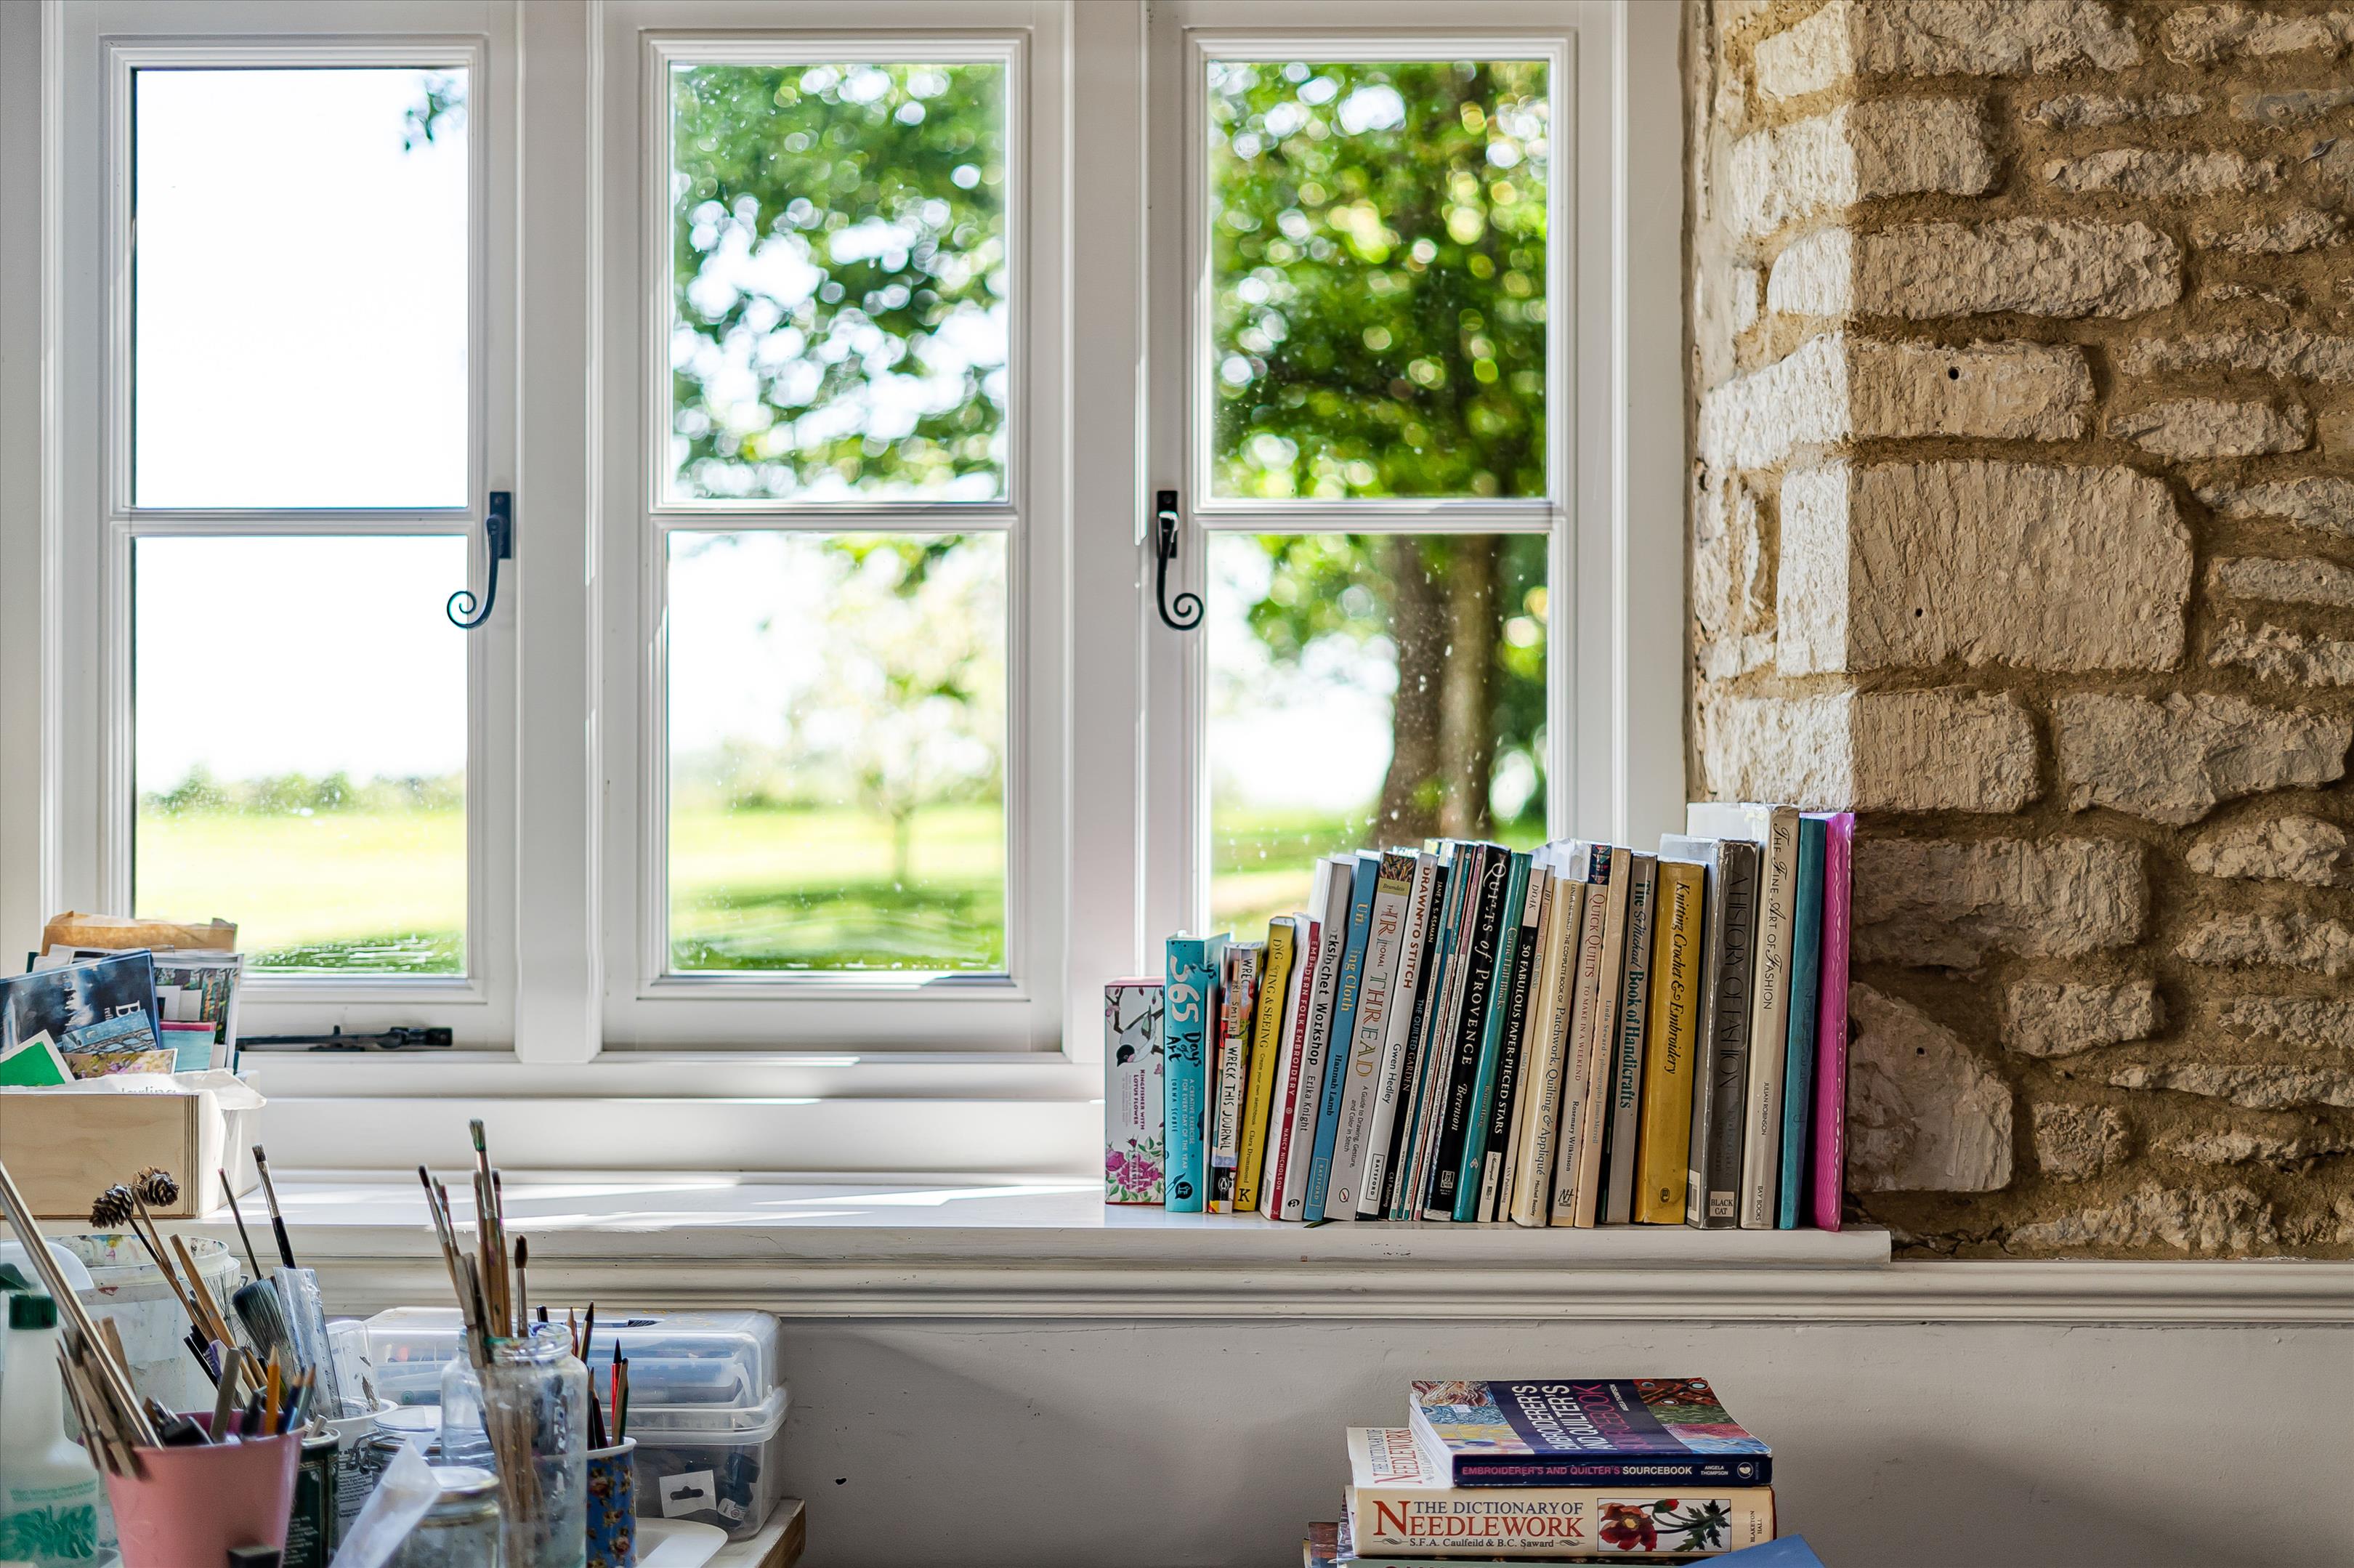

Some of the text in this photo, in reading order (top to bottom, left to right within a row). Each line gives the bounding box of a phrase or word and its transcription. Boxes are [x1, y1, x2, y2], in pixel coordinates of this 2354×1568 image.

[1633, 880, 1650, 907] The
[1729, 872, 1748, 886] A
[1725, 892, 1747, 966] HISTORY
[1763, 823, 1790, 1010] THE FINE ART OF FASHION
[1475, 939, 1493, 963] of
[1585, 894, 1605, 978] QUICK QUILTS
[1403, 942, 1420, 988] STITCH
[1560, 945, 1569, 975] COMPLETE
[1665, 882, 1691, 1074] Knitting Crochet & Embroidery
[1168, 955, 1200, 1023] 365
[1340, 974, 1357, 1011] Cloth
[1557, 994, 1564, 1003] OF
[1583, 985, 1590, 995] TO
[1626, 971, 1643, 1006] Book
[1723, 977, 1743, 1000] OF
[1229, 1001, 1239, 1032] SMITH
[1259, 1006, 1274, 1048] SEEING
[1356, 971, 1388, 1078] THREAD
[1462, 969, 1489, 1065] PROVENCE
[1580, 998, 1589, 1020] MAKE
[1625, 1009, 1641, 1024] of
[1166, 1035, 1183, 1063] Art
[1184, 1031, 1201, 1067] Days
[1287, 999, 1307, 1096] FOLK EMBROIDERY
[1306, 1003, 1328, 1065] Workshop
[1402, 999, 1424, 1091] THE QUILTED GARDEN
[1494, 944, 1531, 1133] 50 FABULOUS PAPER-PIECED STARS
[1601, 1025, 1609, 1051] Seward
[1718, 1010, 1741, 1088] FASHION
[1381, 1043, 1402, 1104] Gwen Hedley
[1574, 1041, 1585, 1080] WEEKEND
[1595, 1058, 1606, 1099] photographs
[1619, 1025, 1639, 1108] Handicrafts
[1219, 1046, 1238, 1149] WRECK THIS JOURNAL
[1298, 1075, 1316, 1131] Erika Knight
[1325, 1054, 1343, 1115] Hannah Lamb
[1358, 1091, 1367, 1109] Guide
[1534, 1006, 1566, 1174] Patchwork, Quilting & Appliqué
[1346, 1112, 1355, 1127] Color
[1451, 1083, 1467, 1131] Berenson
[1182, 1128, 1188, 1137] OF
[1343, 1135, 1352, 1152] Stitch
[1353, 1117, 1364, 1141] Drawing,
[1566, 1101, 1579, 1171] Rosemary Wilkinson
[1592, 1120, 1601, 1143] Merrell
[1243, 1130, 1255, 1183] Clara Drummond
[1275, 1128, 1290, 1189] NANCY NICHOLSON
[1349, 1144, 1359, 1168] Gesture,
[1238, 1188, 1251, 1203] K
[1314, 1164, 1324, 1200] BATSFORD
[1370, 1159, 1380, 1195] BATSFORD
[1541, 1385, 1599, 1436] QUILTER'S
[1372, 1463, 1389, 1472] THE
[1373, 1429, 1423, 1484] NEEDLEWORK
[1462, 1466, 1692, 1475] EMBROIDERER'S AND QUILTER'S SOURCEBOOK
[1372, 1500, 1585, 1537] NEEDLEWORK
[1414, 1501, 1583, 1514] THE DICTIONARY OF
[1443, 1538, 1484, 1548] Caulfeild
[1486, 1539, 1494, 1548] &
[1497, 1539, 1517, 1548] B.C.
[1520, 1538, 1554, 1548] Saward
